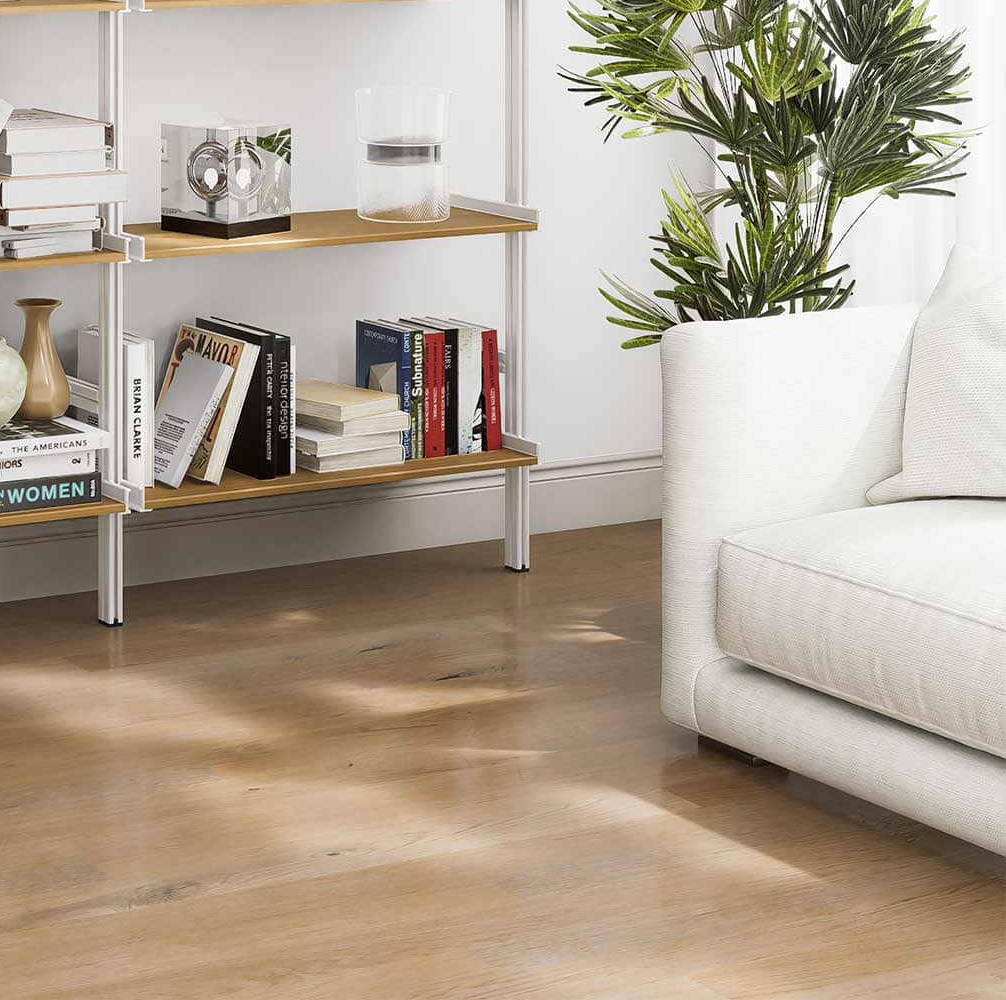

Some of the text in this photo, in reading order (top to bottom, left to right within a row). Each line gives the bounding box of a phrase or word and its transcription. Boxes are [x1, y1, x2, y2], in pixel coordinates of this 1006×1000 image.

[194, 334, 239, 366] MAYOR
[412, 333, 423, 398] Subnature
[133, 378, 141, 459] BRIAN CLARKE
[11, 446, 31, 454] THE
[32, 439, 88, 452] AMERICANS
[71, 457, 81, 465] 2
[7, 481, 85, 504] WOMEN
